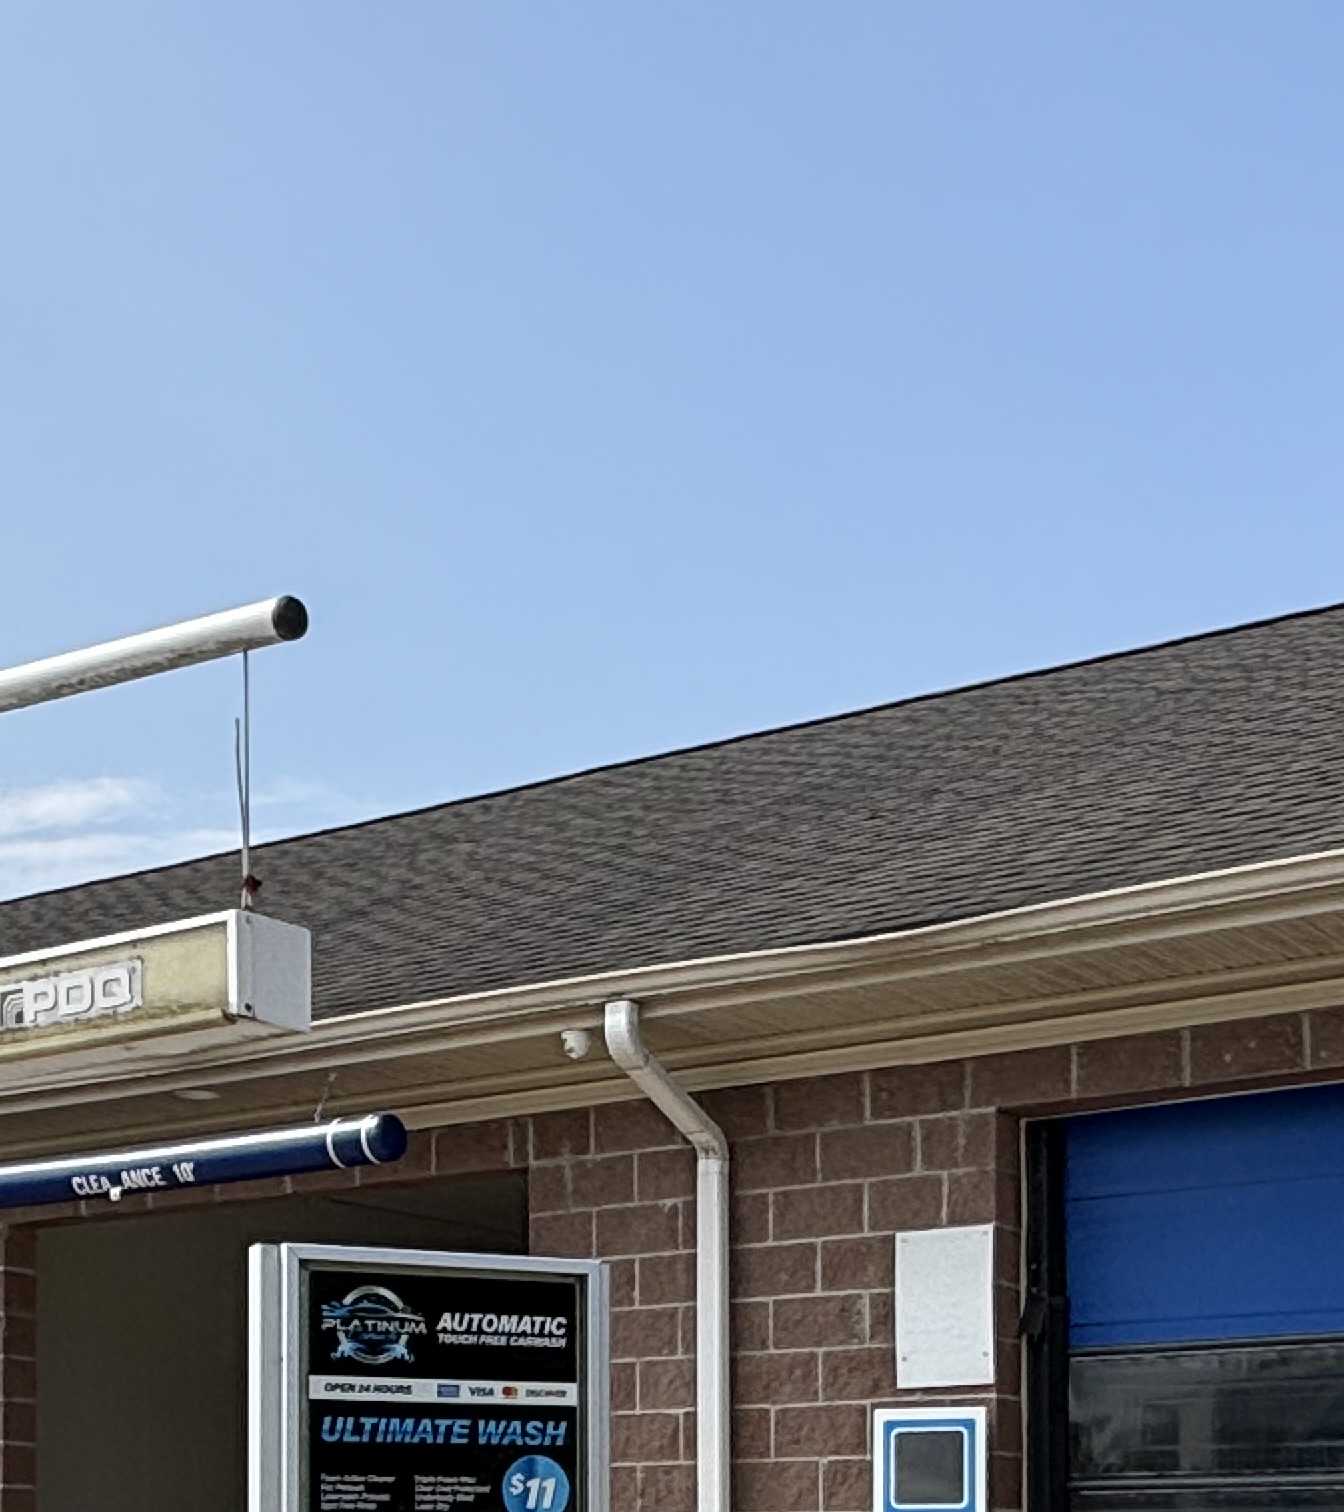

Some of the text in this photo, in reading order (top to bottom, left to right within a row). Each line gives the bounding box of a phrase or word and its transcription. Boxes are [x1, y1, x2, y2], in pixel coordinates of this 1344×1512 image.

[23, 968, 133, 1023] PDQ
[71, 1166, 167, 1196] CLEAANCE
[321, 1319, 427, 1335] PLATINUM
[436, 1312, 568, 1335] AUTOMATIC
[324, 1383, 356, 1394] OPEN
[469, 1387, 495, 1397] VISA
[321, 1416, 567, 1446] ULTIMATE WASH
[509, 1473, 556, 1510] $11
